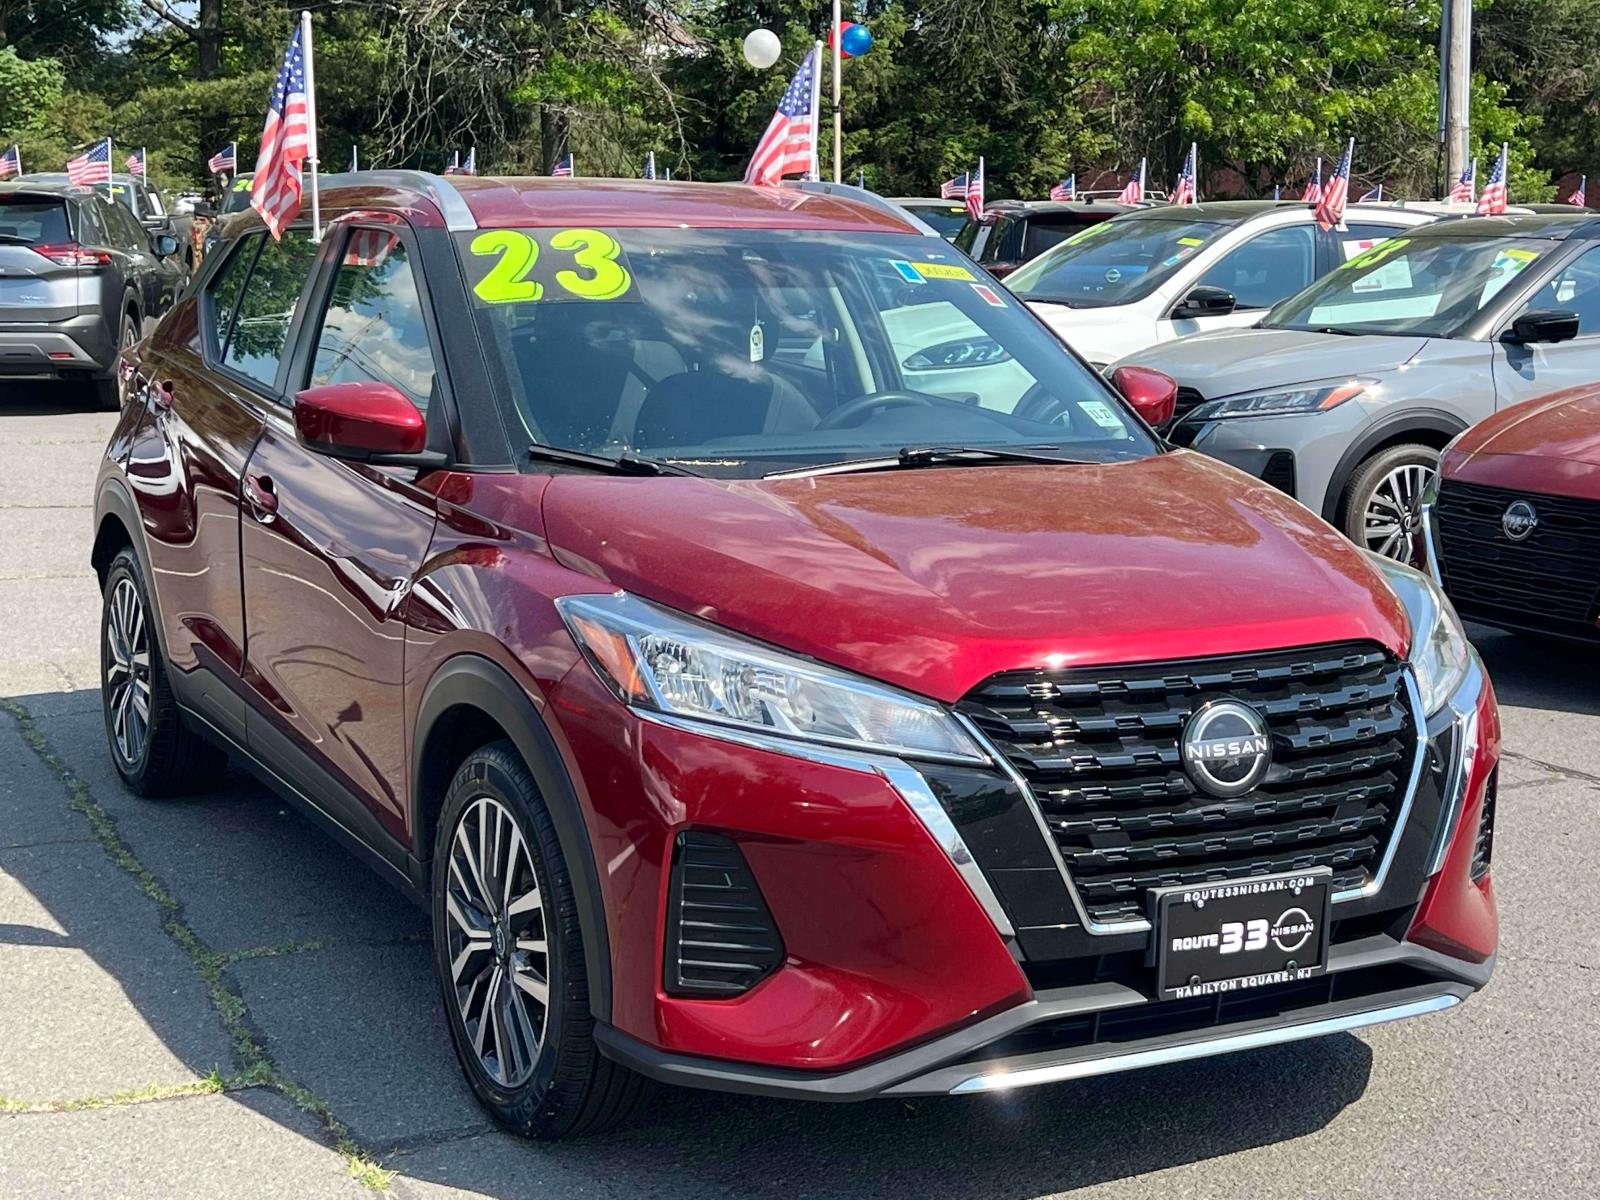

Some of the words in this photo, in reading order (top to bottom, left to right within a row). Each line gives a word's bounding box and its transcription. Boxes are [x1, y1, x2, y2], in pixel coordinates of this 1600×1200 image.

[470, 229, 632, 304] 23
[1188, 737, 1267, 758] NISSAN
[1183, 877, 1315, 902] ROUTE33NISSAN.COM
[1172, 933, 1219, 951] ROUTE
[1219, 918, 1270, 954] 33
[1270, 922, 1315, 937] NISSAN
[1175, 979, 1237, 999] HAMILTON
[1297, 968, 1312, 979] NJ
